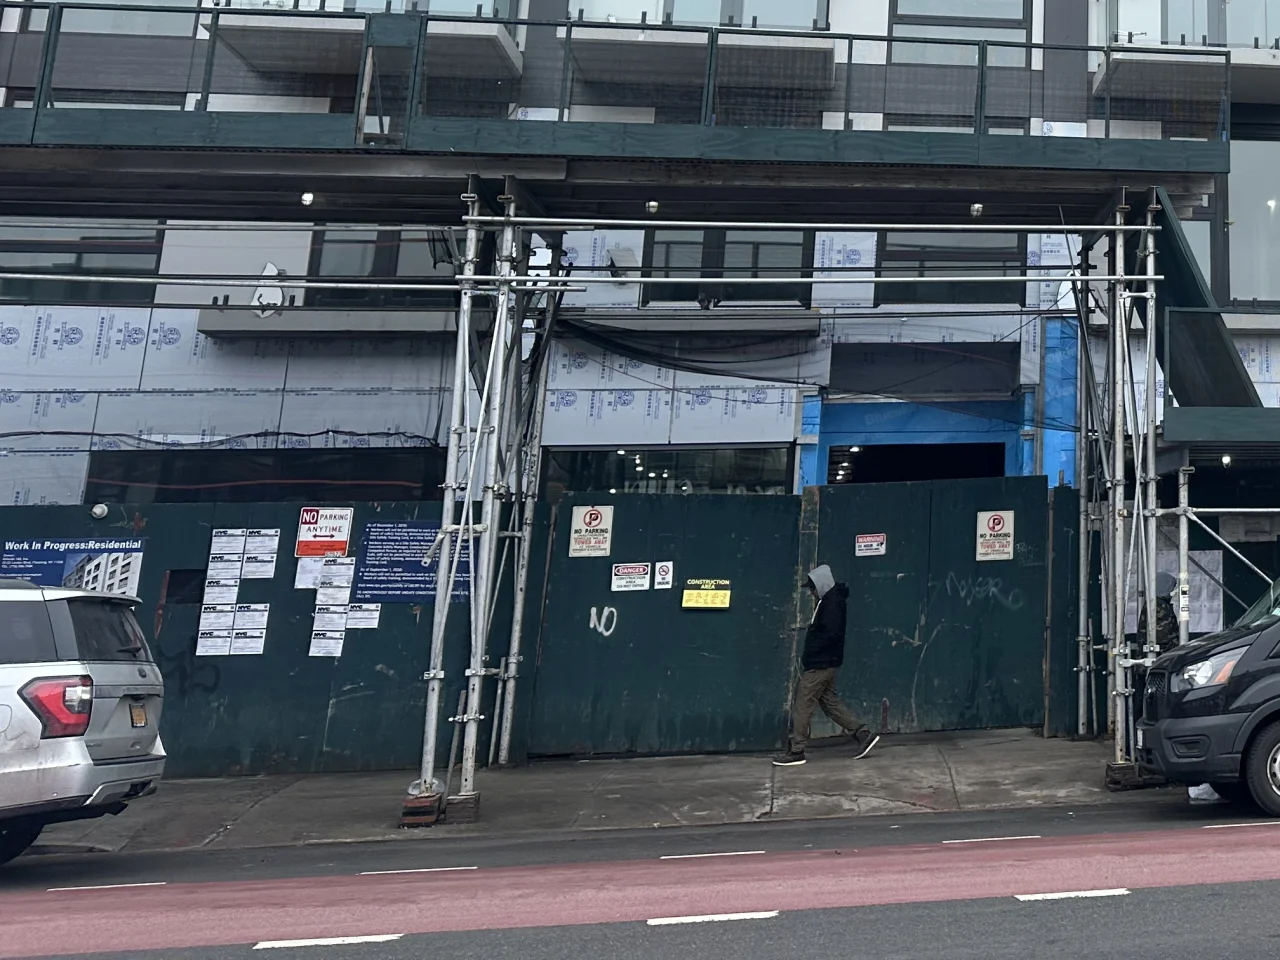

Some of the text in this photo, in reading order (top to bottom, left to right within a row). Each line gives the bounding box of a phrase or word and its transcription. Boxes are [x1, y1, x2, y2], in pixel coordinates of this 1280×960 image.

[302, 511, 349, 523] NO PARKING
[5, 541, 29, 550] Work
[32, 541, 41, 550] In
[589, 606, 617, 636] NO
